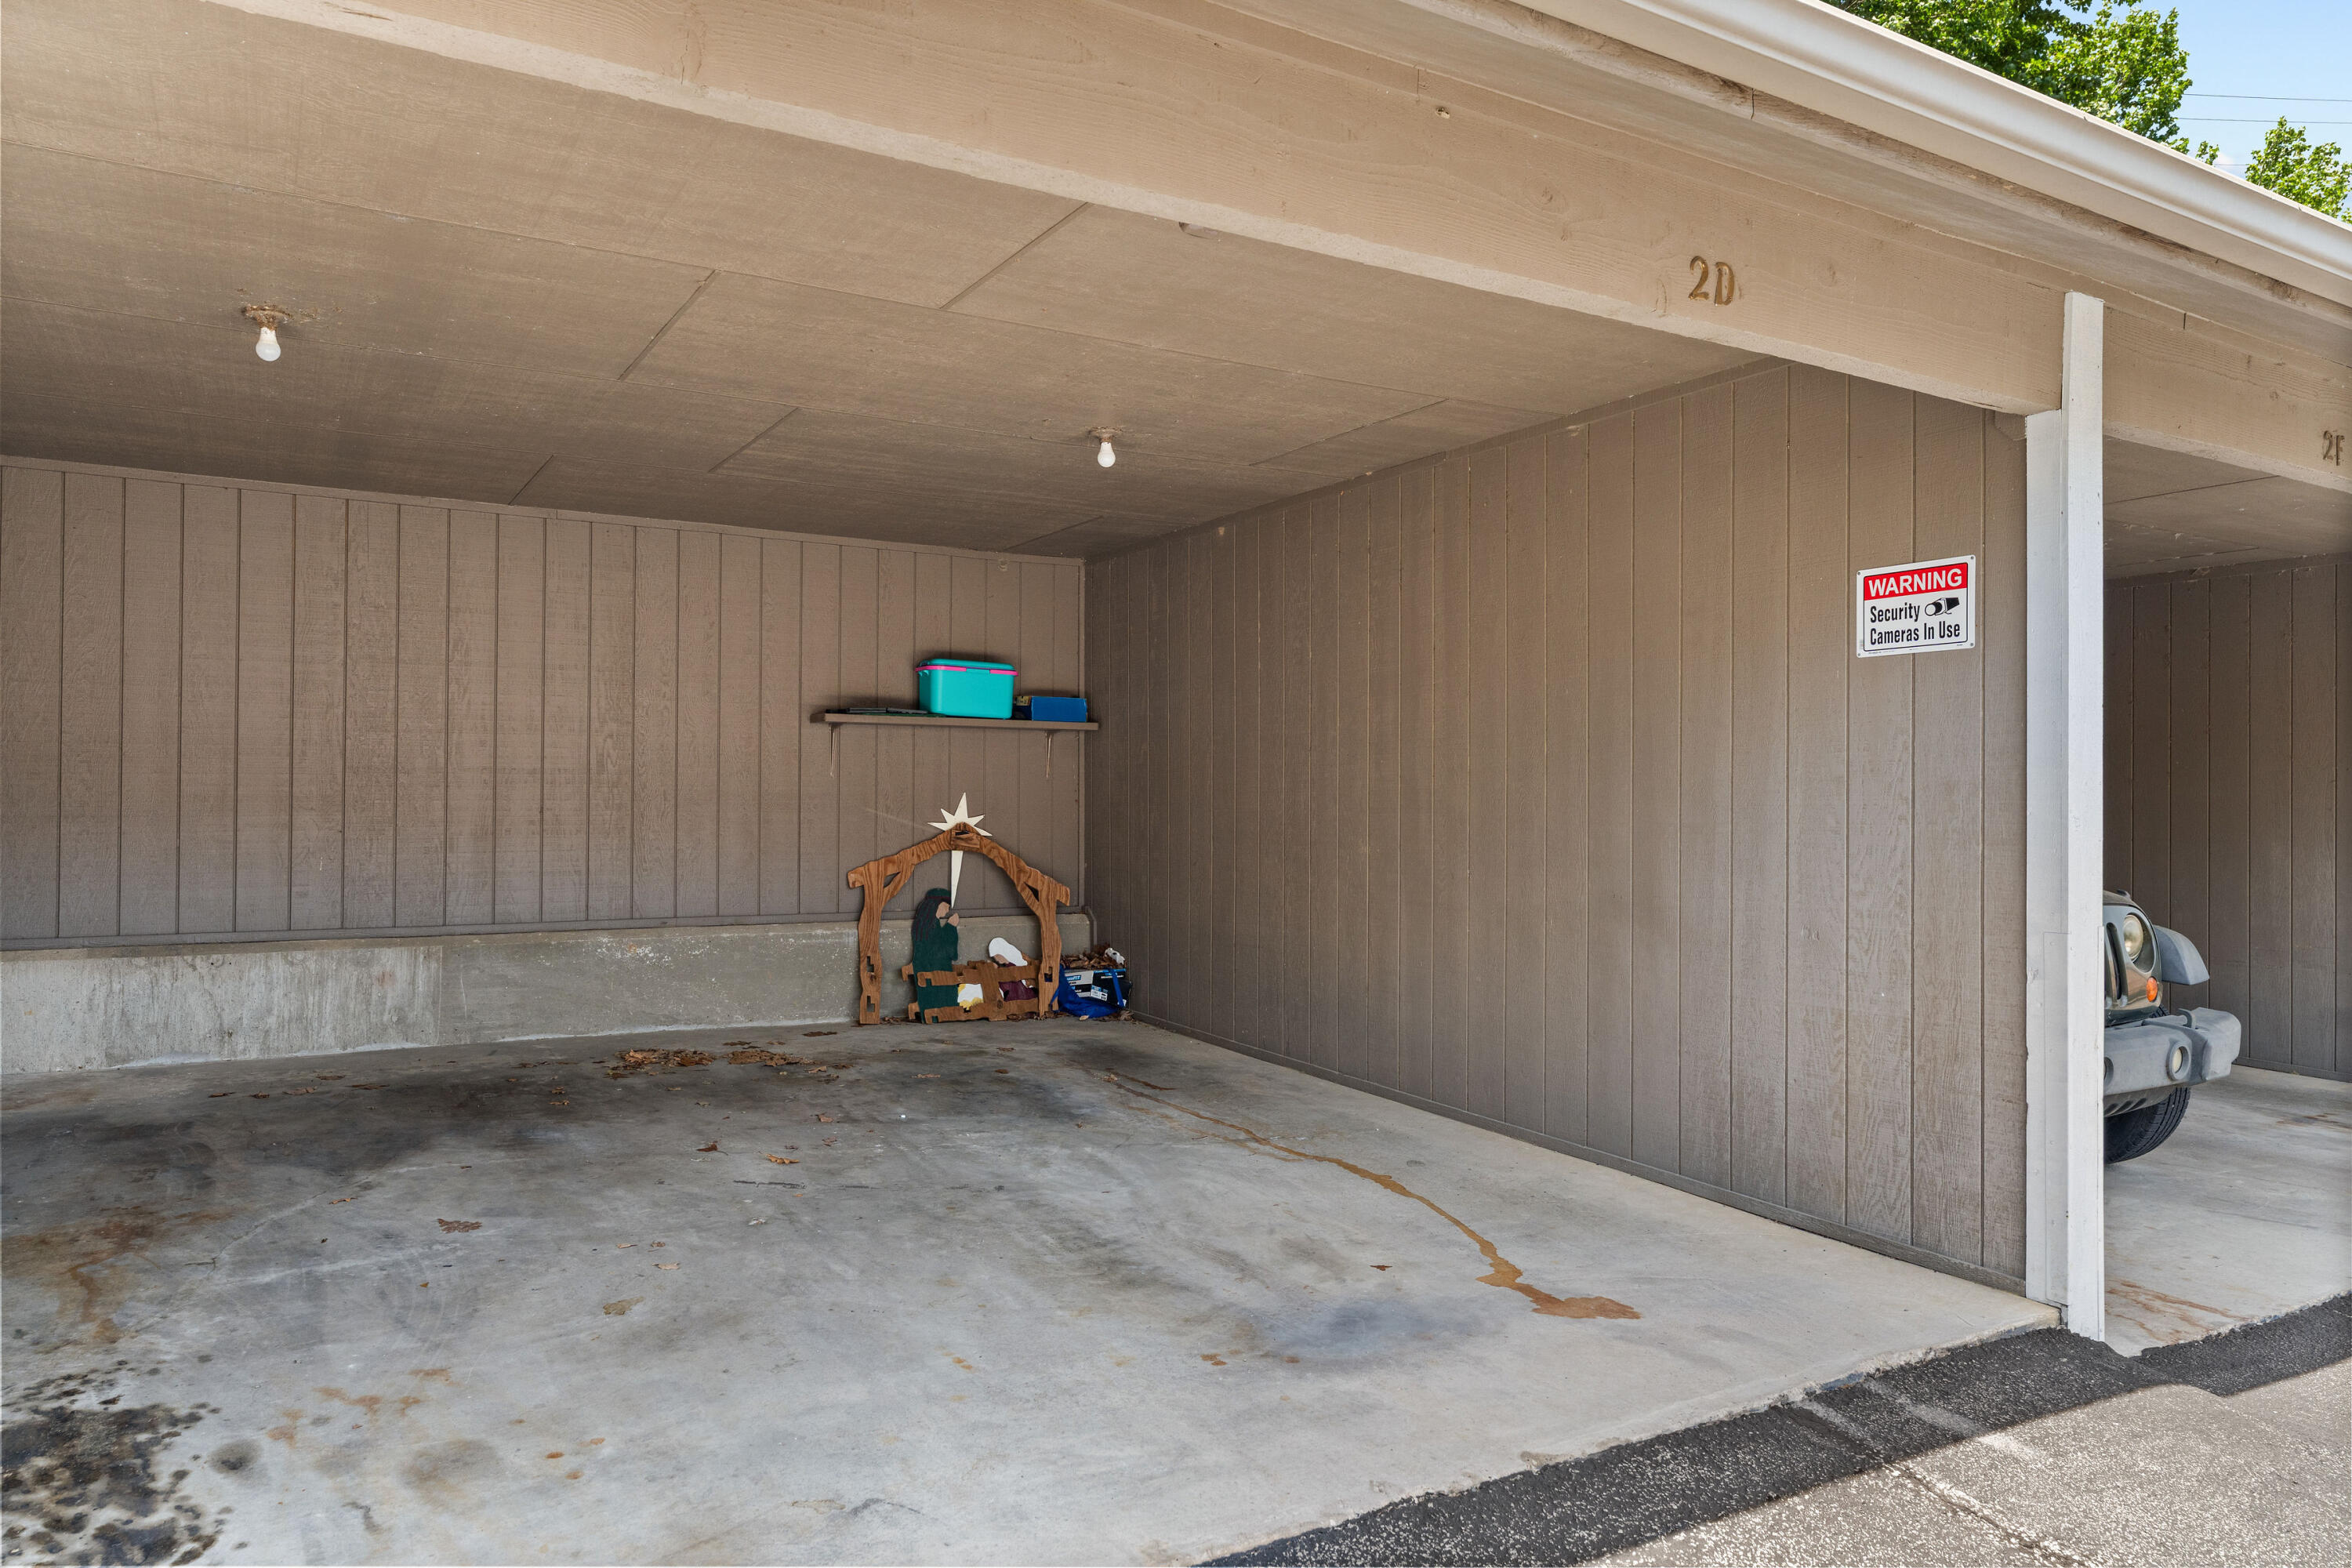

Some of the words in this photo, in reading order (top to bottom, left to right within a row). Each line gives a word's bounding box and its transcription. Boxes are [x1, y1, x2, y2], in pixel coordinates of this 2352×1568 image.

[1689, 256, 1734, 306] 2D
[2323, 430, 2345, 466] 2F
[1868, 568, 1962, 597] WARNING
[1871, 602, 1920, 623] Security
[1870, 628, 1919, 645] Cameras
[1924, 622, 1934, 640] In
[1939, 621, 1960, 638] Use
